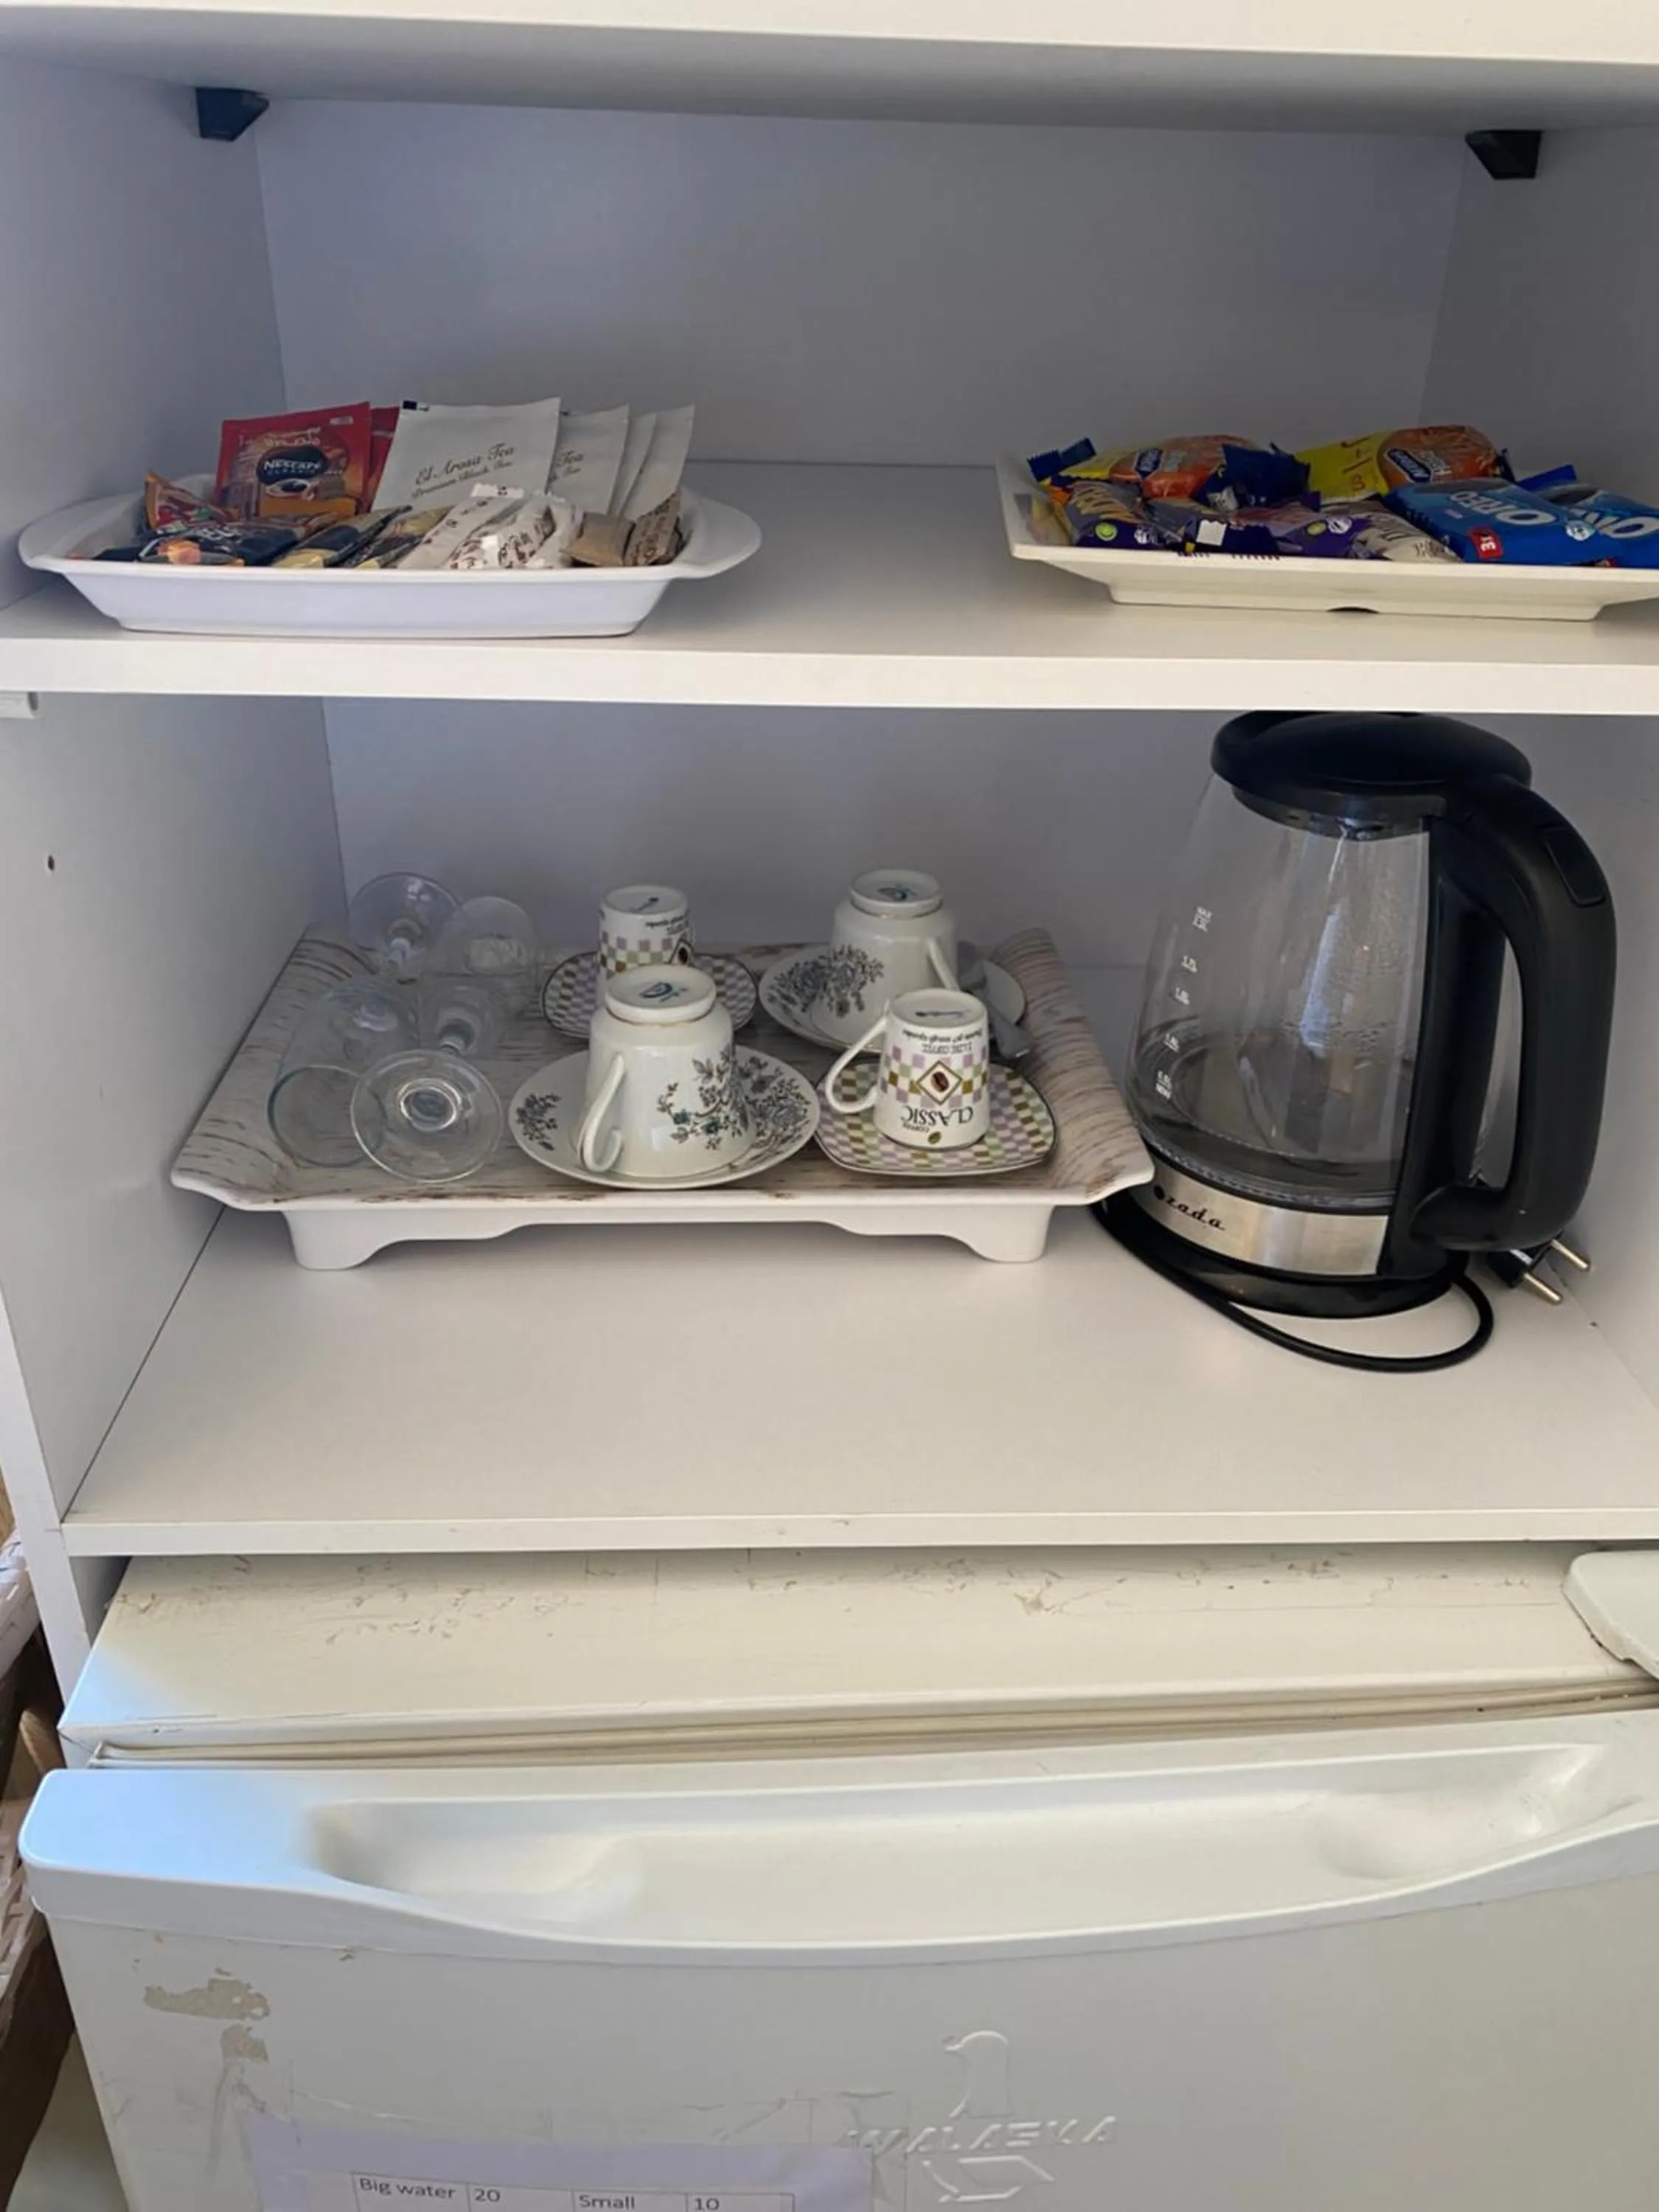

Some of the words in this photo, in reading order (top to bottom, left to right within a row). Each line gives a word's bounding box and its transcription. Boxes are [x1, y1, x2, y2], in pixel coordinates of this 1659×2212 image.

[900, 1106, 973, 1127] CLASSIC
[359, 2177, 392, 2195] Big
[396, 2184, 456, 2199] water
[474, 2188, 501, 2202] 20
[579, 2194, 635, 2209] Small
[694, 2197, 720, 2211] 10
